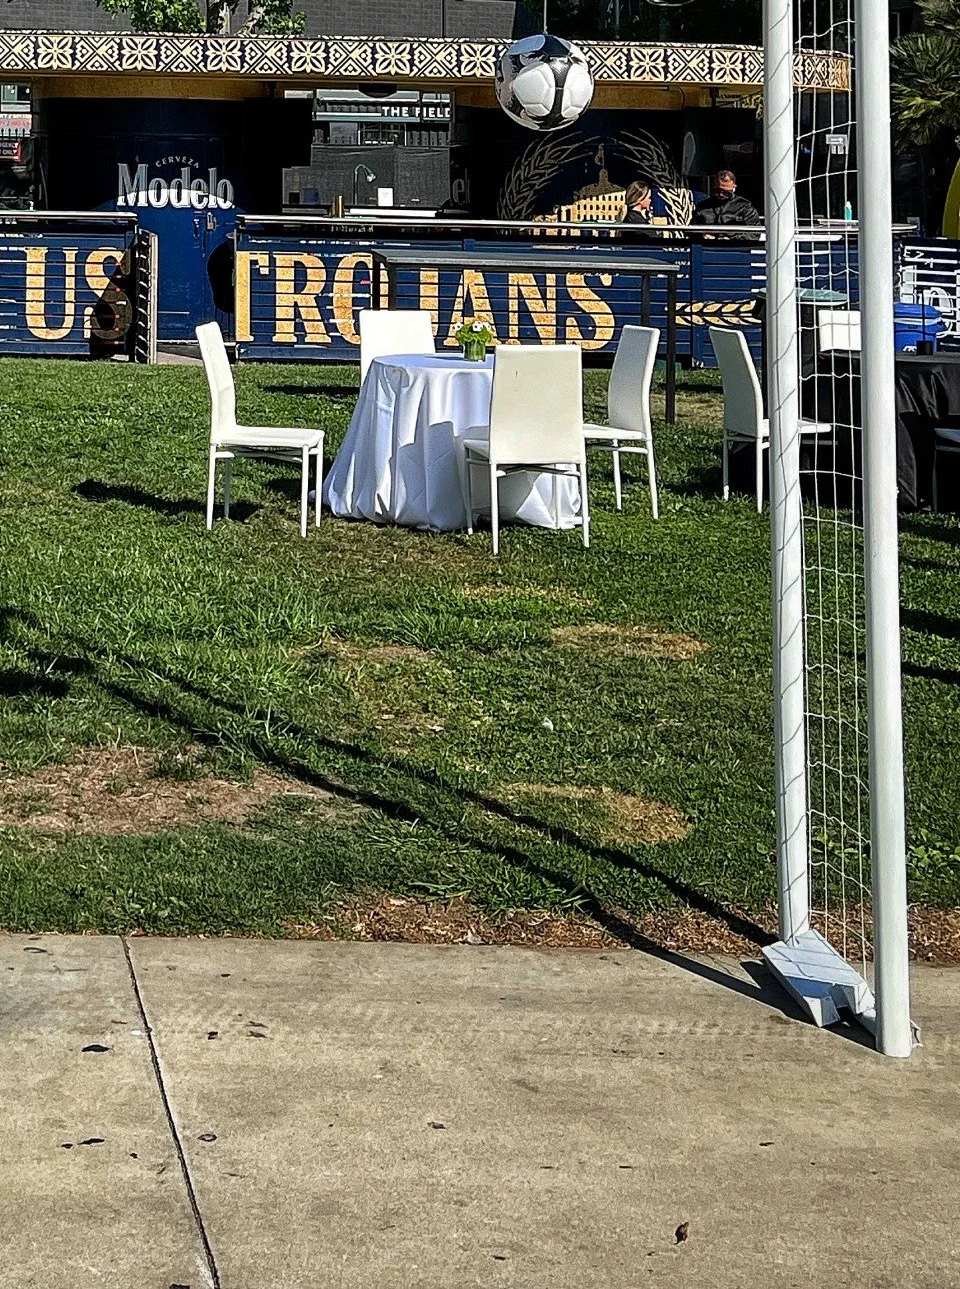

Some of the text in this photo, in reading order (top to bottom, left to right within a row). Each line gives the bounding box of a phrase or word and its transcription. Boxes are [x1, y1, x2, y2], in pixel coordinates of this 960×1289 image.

[382, 106, 409, 118] THE
[155, 155, 200, 169] CERVEZA
[116, 162, 235, 210] Modelo
